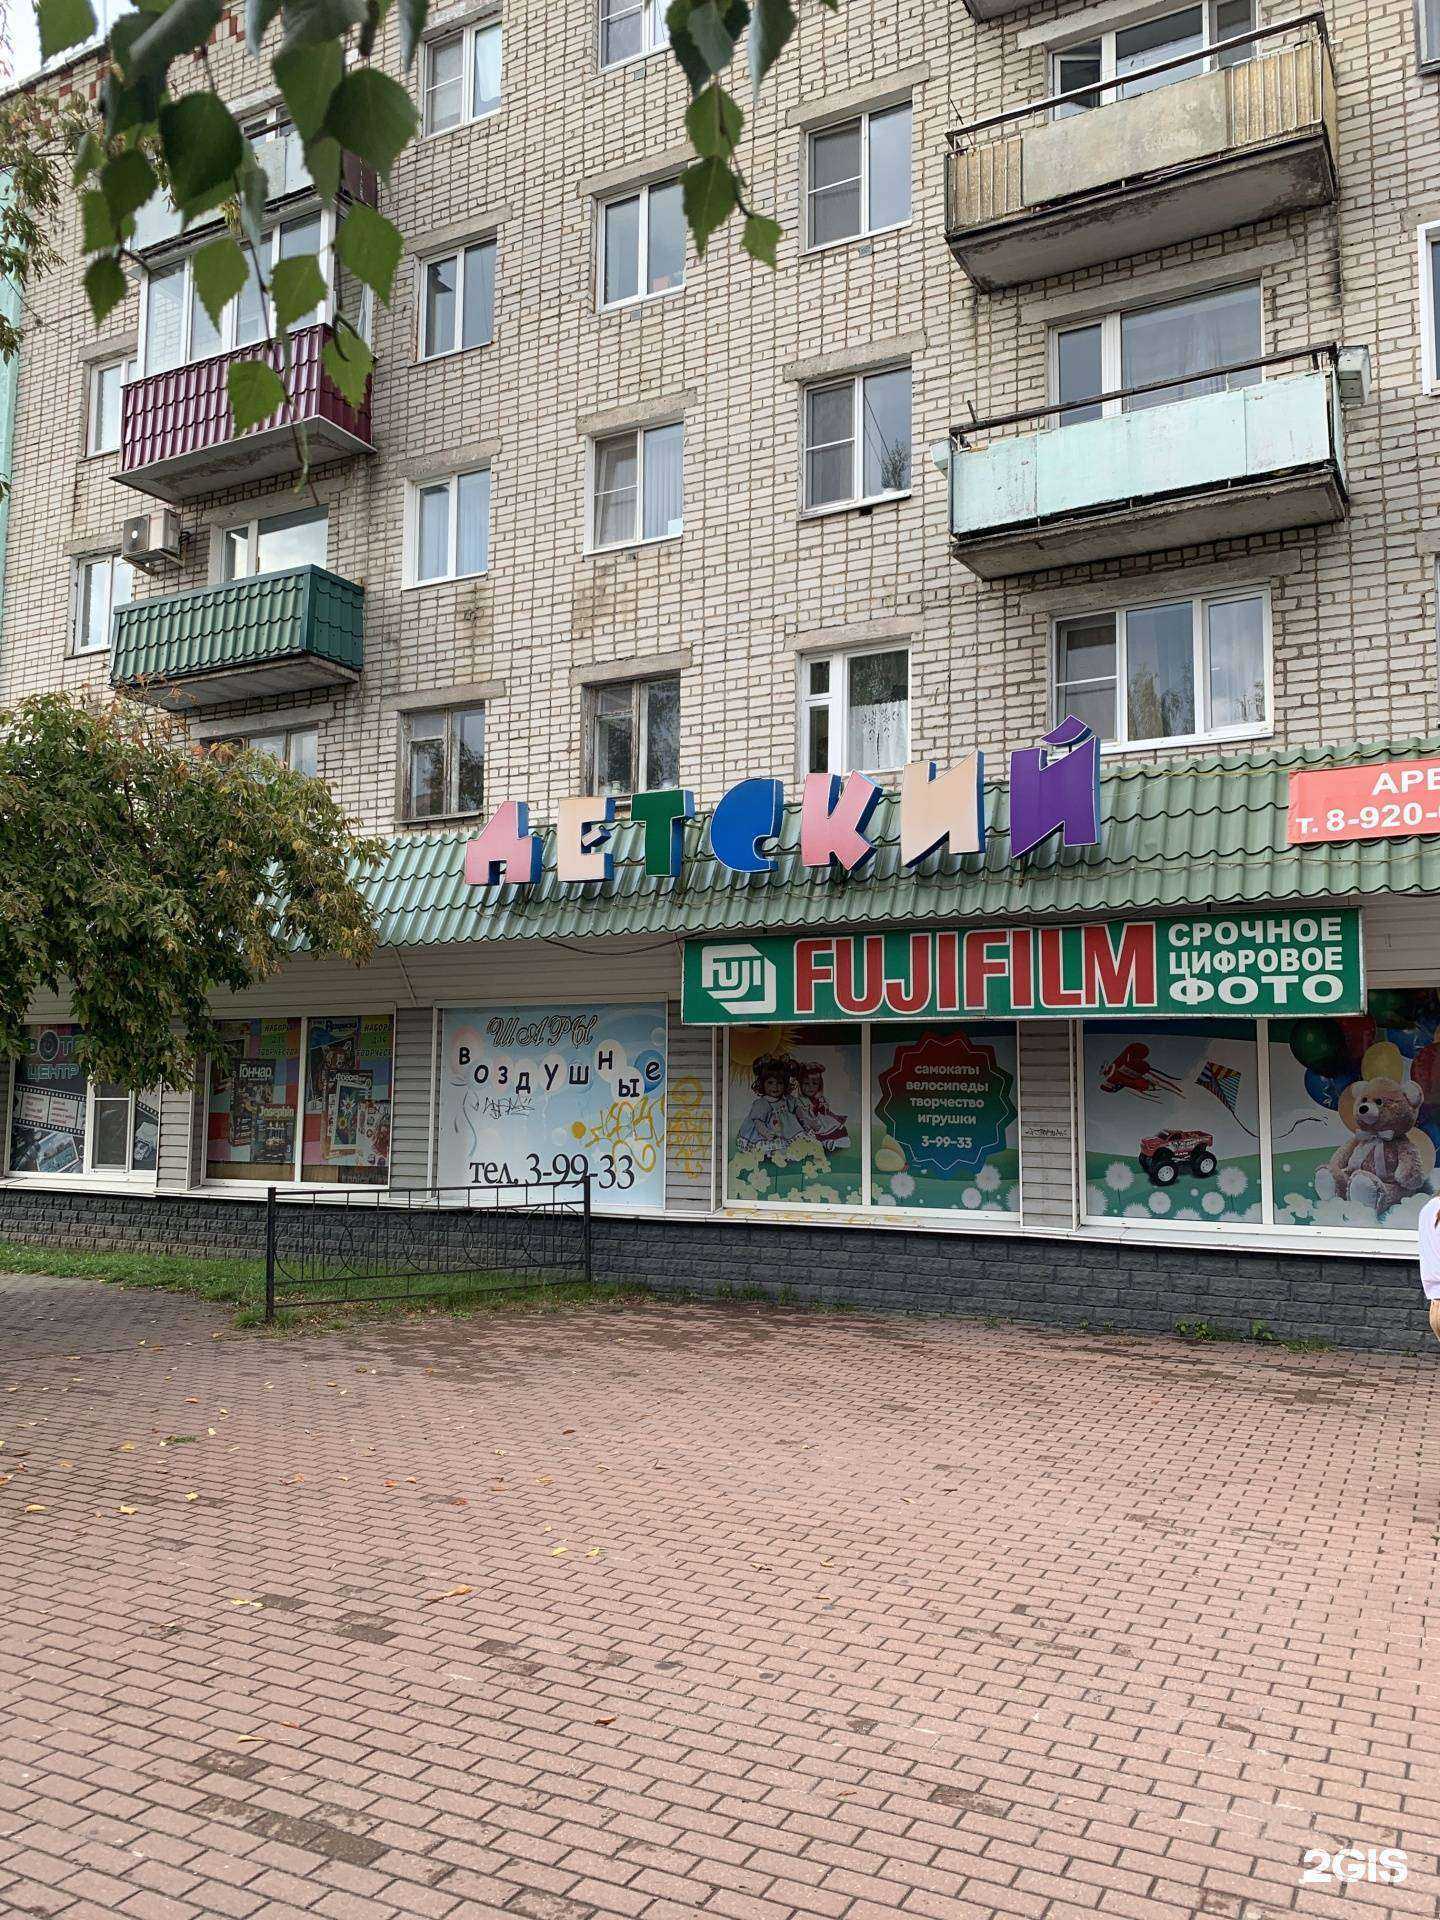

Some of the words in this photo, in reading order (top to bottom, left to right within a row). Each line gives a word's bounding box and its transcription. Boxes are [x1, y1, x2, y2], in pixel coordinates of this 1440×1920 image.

[465, 714, 1099, 886] ДЕТСКИЙ
[1326, 802, 1440, 832] 8-920-
[1168, 917, 1342, 946] СРОЧНОЕ
[702, 944, 771, 1007] FUJI
[793, 922, 1158, 1015] FUJIFILM
[1169, 947, 1344, 979] ЦИФРОВОЕ
[1169, 973, 1344, 1005] ФОТО
[486, 1014, 598, 1048] ШАРЫ
[914, 1065, 979, 1075] самокаты
[905, 1082, 989, 1093] велосипеды
[910, 1097, 985, 1109] творчество
[917, 1113, 977, 1126] игрушки
[921, 1135, 973, 1149] 3-99-33
[469, 1161, 519, 1185] тел.
[525, 1152, 636, 1190] 3-99-33
